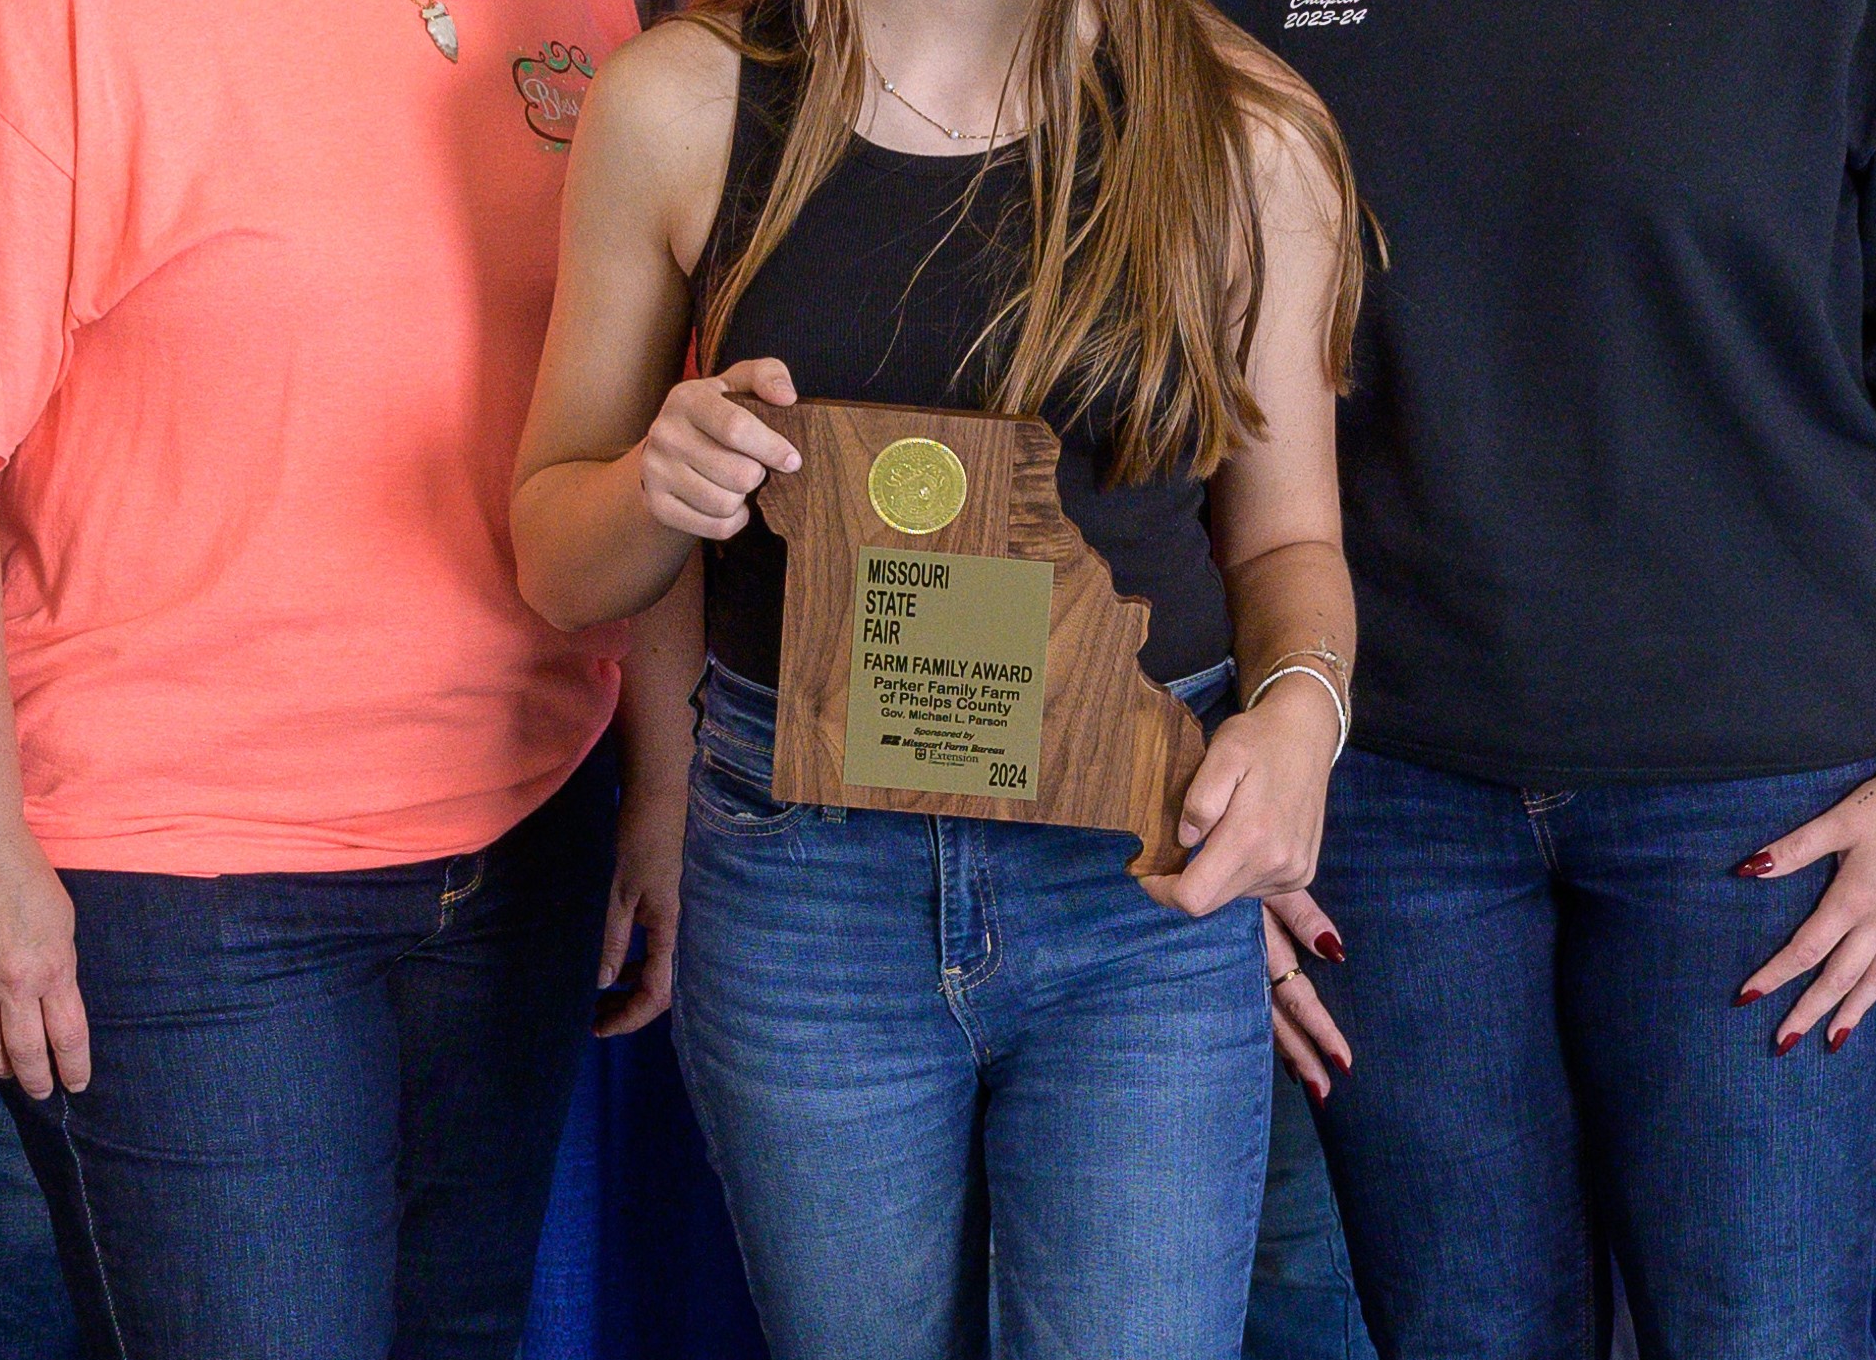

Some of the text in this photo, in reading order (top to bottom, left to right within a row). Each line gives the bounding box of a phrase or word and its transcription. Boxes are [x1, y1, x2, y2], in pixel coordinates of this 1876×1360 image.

[1284, 8, 1368, 29] 2023-24
[867, 558, 950, 589] MISSOURI
[865, 589, 917, 617] STATE
[863, 618, 901, 645] FAIR
[863, 652, 1033, 683] FARM FAMILY AWARD
[873, 676, 1020, 701] Parker Family Farm
[879, 692, 1012, 717] of Phelps County
[880, 707, 1008, 728] Gov. Michael L. Parson
[901, 738, 1006, 756] Missouri Farm Bureau
[913, 727, 976, 742] Sponsored by
[929, 749, 980, 764] Extension
[988, 762, 1028, 789] 2024
